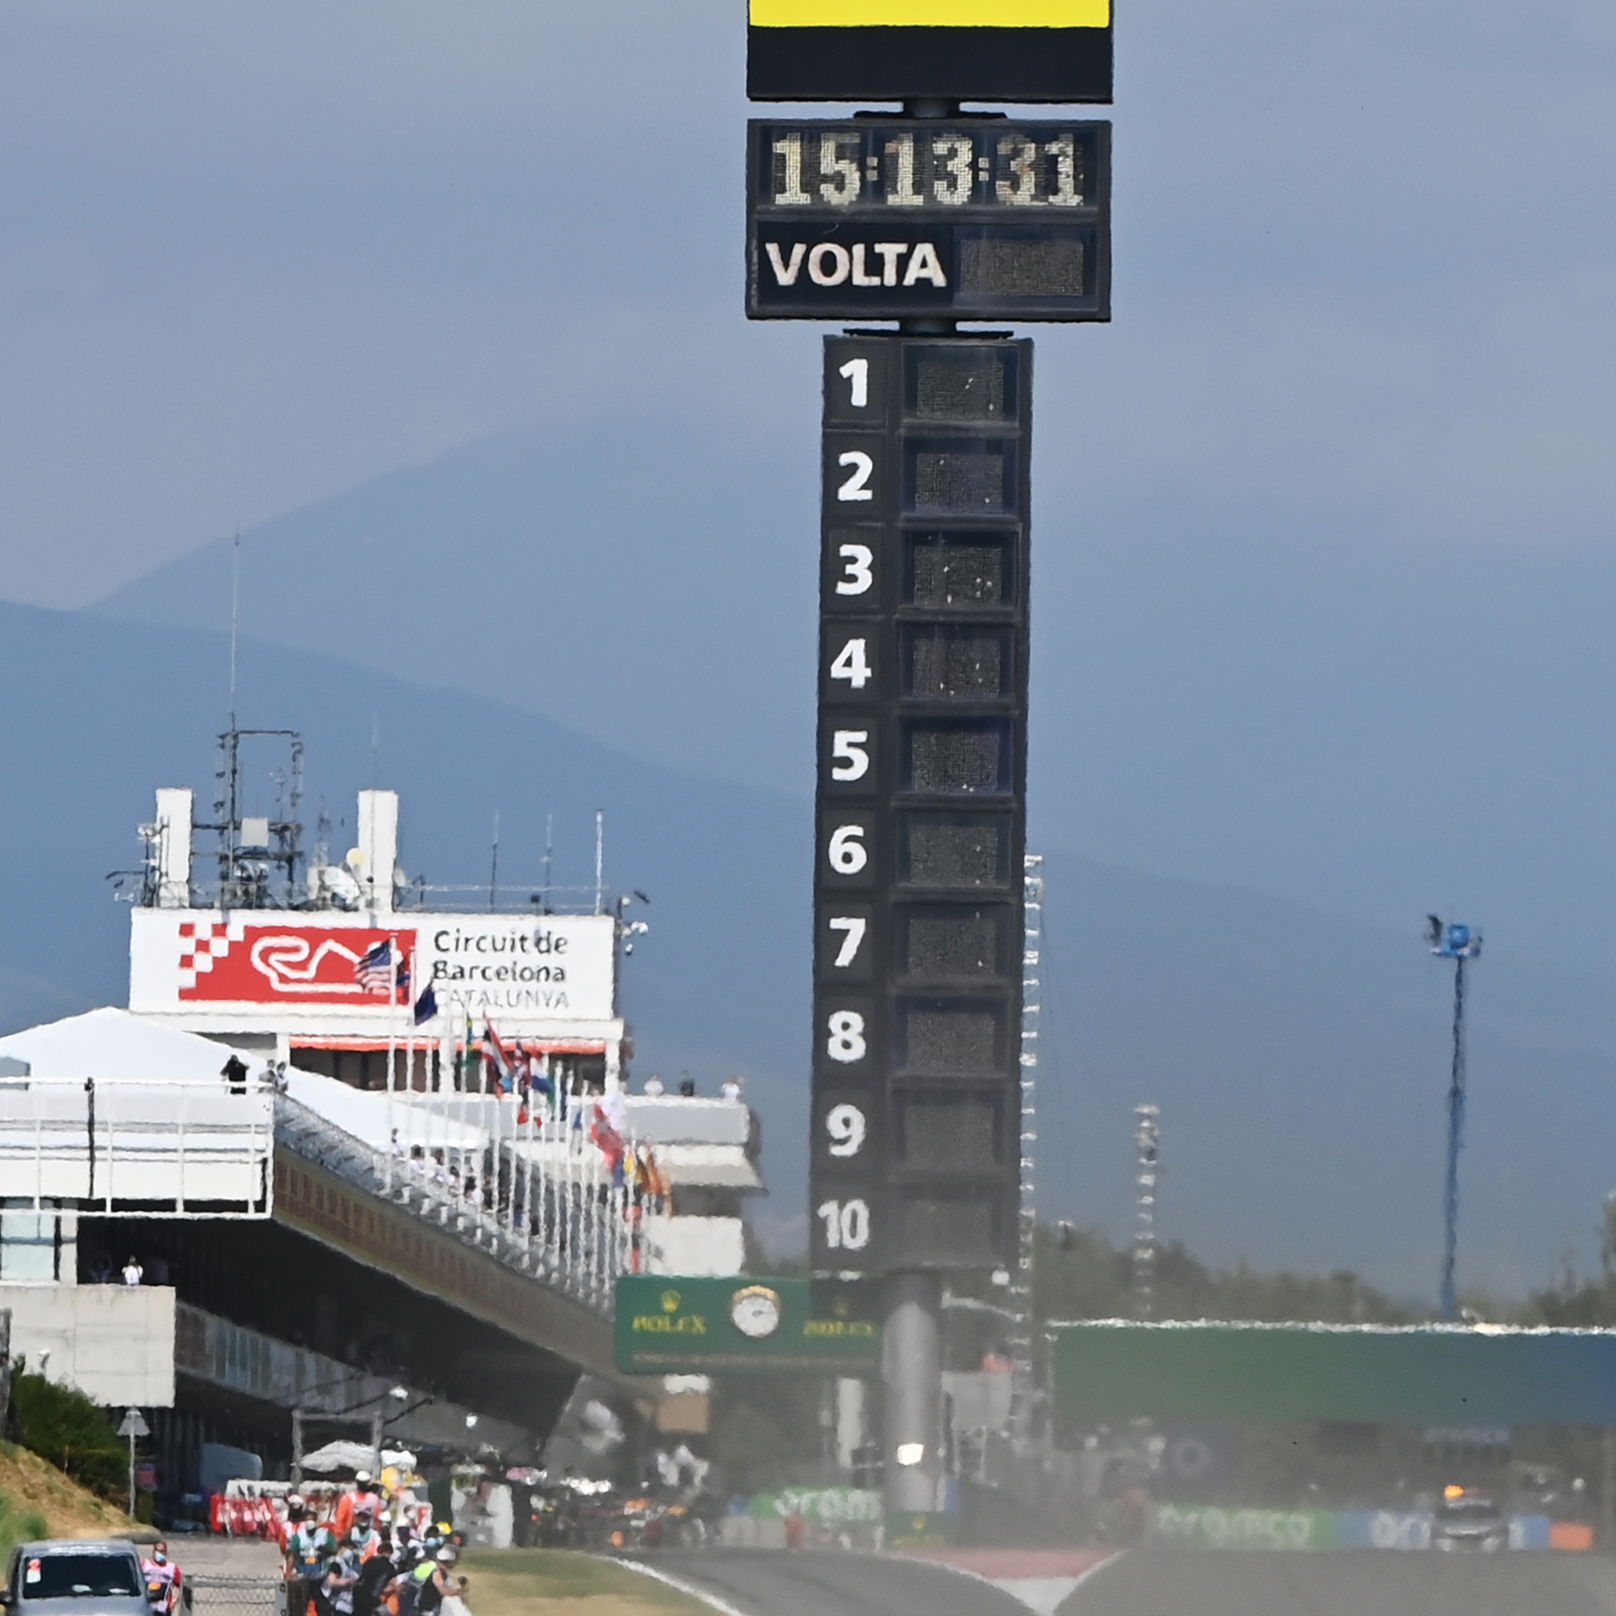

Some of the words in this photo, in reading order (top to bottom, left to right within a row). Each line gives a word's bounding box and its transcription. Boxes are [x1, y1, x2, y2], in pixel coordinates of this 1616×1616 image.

[772, 132, 1084, 206] 15:13:31
[765, 242, 947, 287] VOLTA
[838, 358, 869, 407] 1
[837, 451, 874, 501] 2
[835, 544, 873, 596] 3
[830, 638, 872, 688] 4
[831, 730, 870, 782] 5
[828, 825, 867, 874] 6
[434, 928, 531, 953] Circuit
[536, 930, 568, 954] de
[829, 916, 866, 967] 7
[433, 960, 566, 982] Barcelona
[827, 1010, 866, 1062] 8
[826, 1103, 866, 1157] 9
[817, 1199, 870, 1250] 10
